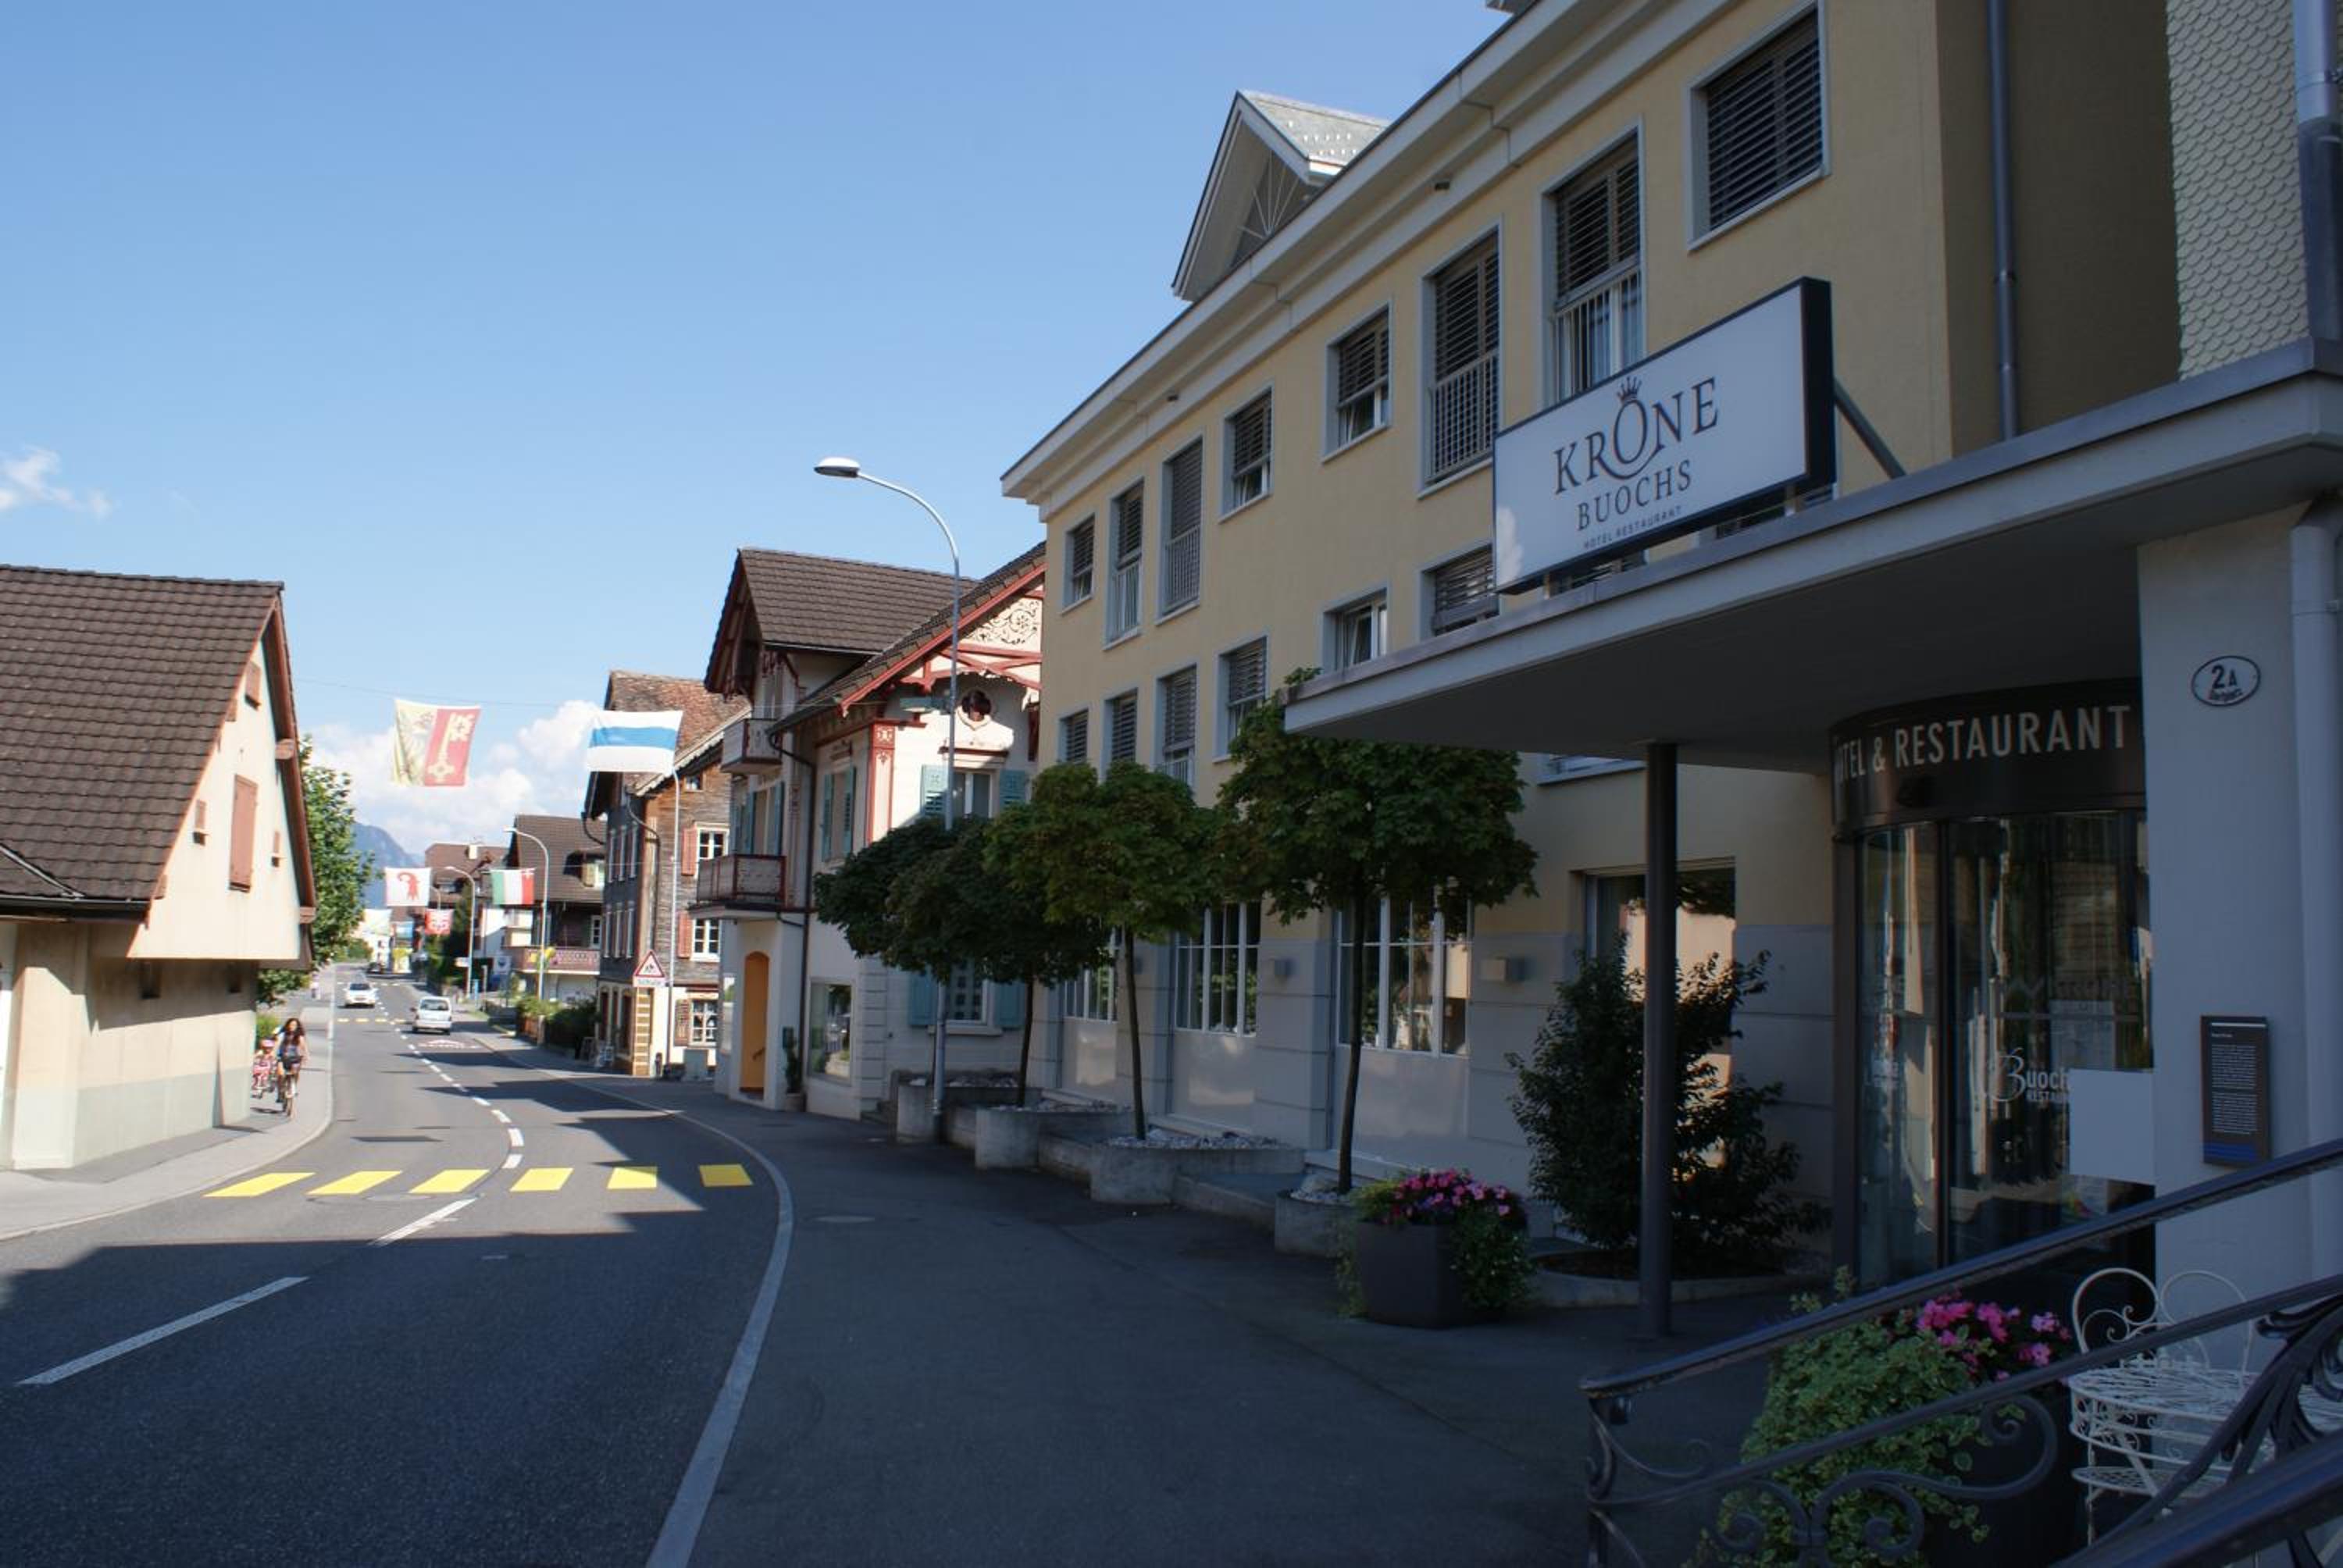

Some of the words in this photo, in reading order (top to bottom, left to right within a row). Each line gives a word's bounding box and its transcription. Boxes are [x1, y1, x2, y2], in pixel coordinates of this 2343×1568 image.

[1553, 377, 1719, 495] KRONE
[1578, 459, 1692, 531] BUOCHS
[1616, 505, 1681, 536] RESTAURANT
[1872, 736, 1886, 772] &
[1895, 705, 2131, 768] RESTAURANT
